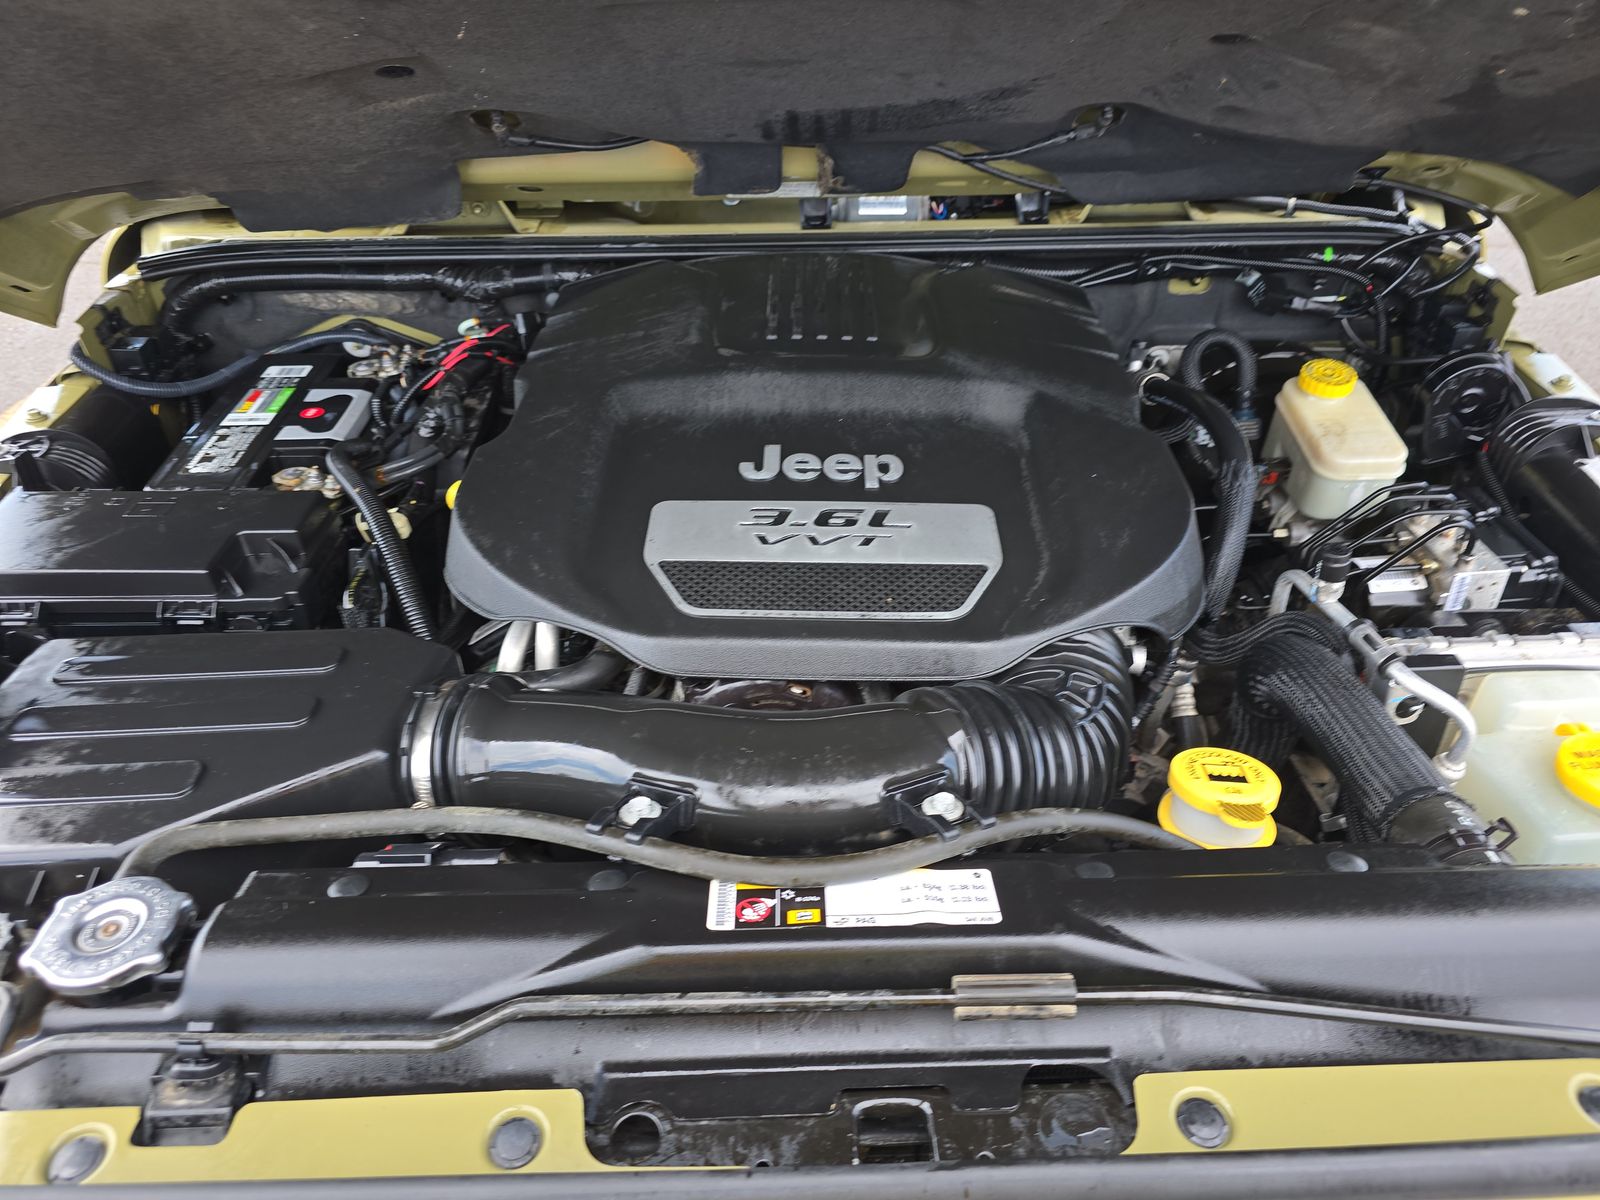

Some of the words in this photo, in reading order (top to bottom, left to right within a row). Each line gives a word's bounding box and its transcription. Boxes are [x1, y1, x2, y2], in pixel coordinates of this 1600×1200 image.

[738, 444, 905, 490] Jeep
[738, 507, 913, 529] 3.6L
[753, 532, 893, 547] VVT
